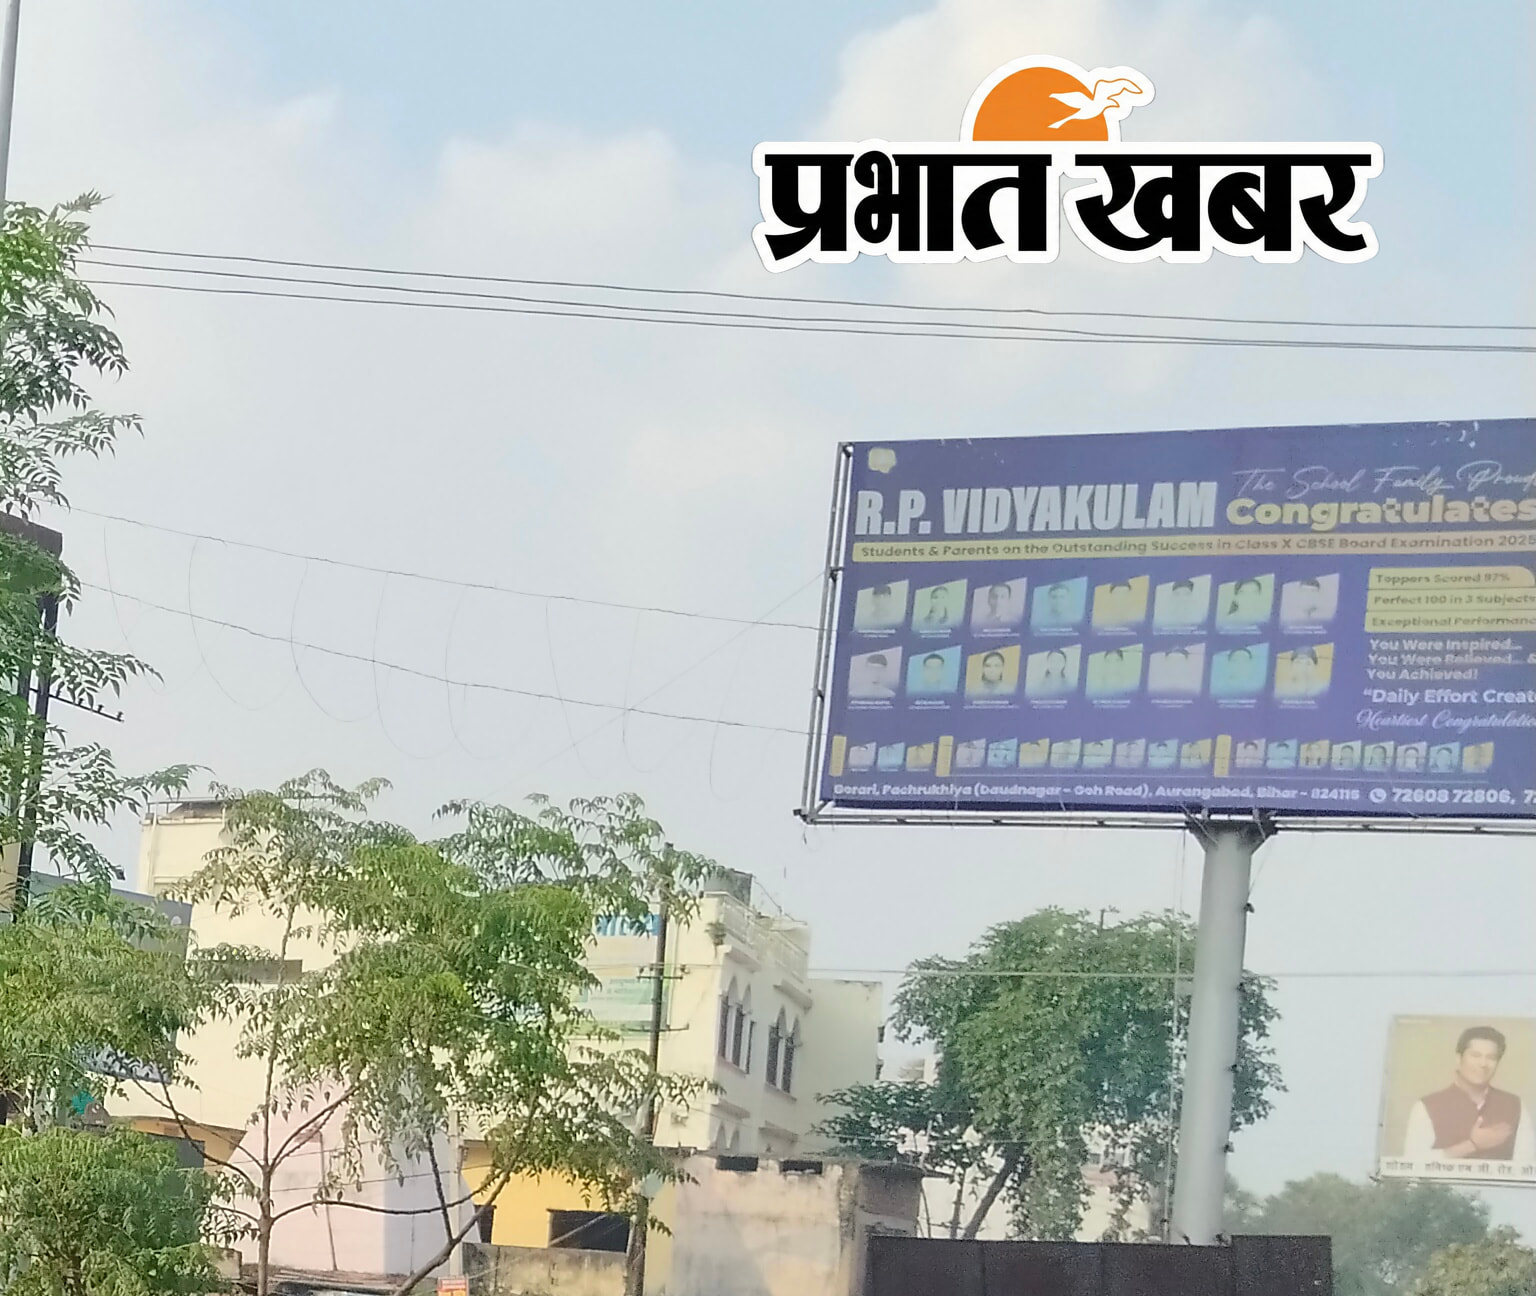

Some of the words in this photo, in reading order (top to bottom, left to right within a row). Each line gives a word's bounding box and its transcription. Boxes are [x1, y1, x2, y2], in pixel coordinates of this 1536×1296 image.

[854, 489, 931, 535] R.P.
[943, 481, 1218, 534] VIDYAKULAM
[1226, 494, 1536, 531] Congratulates
[861, 545, 925, 558] Students
[928, 544, 939, 556] &
[944, 543, 1000, 556] Parents
[1002, 545, 1022, 555] on
[1024, 542, 1049, 554] the
[1053, 540, 1147, 557] Outstanding
[1151, 539, 1213, 552] Success
[1217, 538, 1231, 551] in
[1235, 539, 1277, 551] Class
[1282, 538, 1292, 550] X
[1296, 538, 1334, 550] CBSE
[1339, 536, 1387, 549] Board
[1391, 535, 1495, 549] Examination
[1376, 574, 1430, 586] Toppers
[1434, 573, 1480, 583] Scored
[1374, 596, 1421, 605] Perfect
[1450, 595, 1462, 604] in
[1372, 616, 1452, 628] Exceptional
[1370, 639, 1398, 650] You
[1403, 639, 1443, 650] Were
[1368, 654, 1397, 665] You
[1401, 654, 1442, 665] Were
[1366, 669, 1396, 680] You
[1424, 689, 1478, 703] Effort
